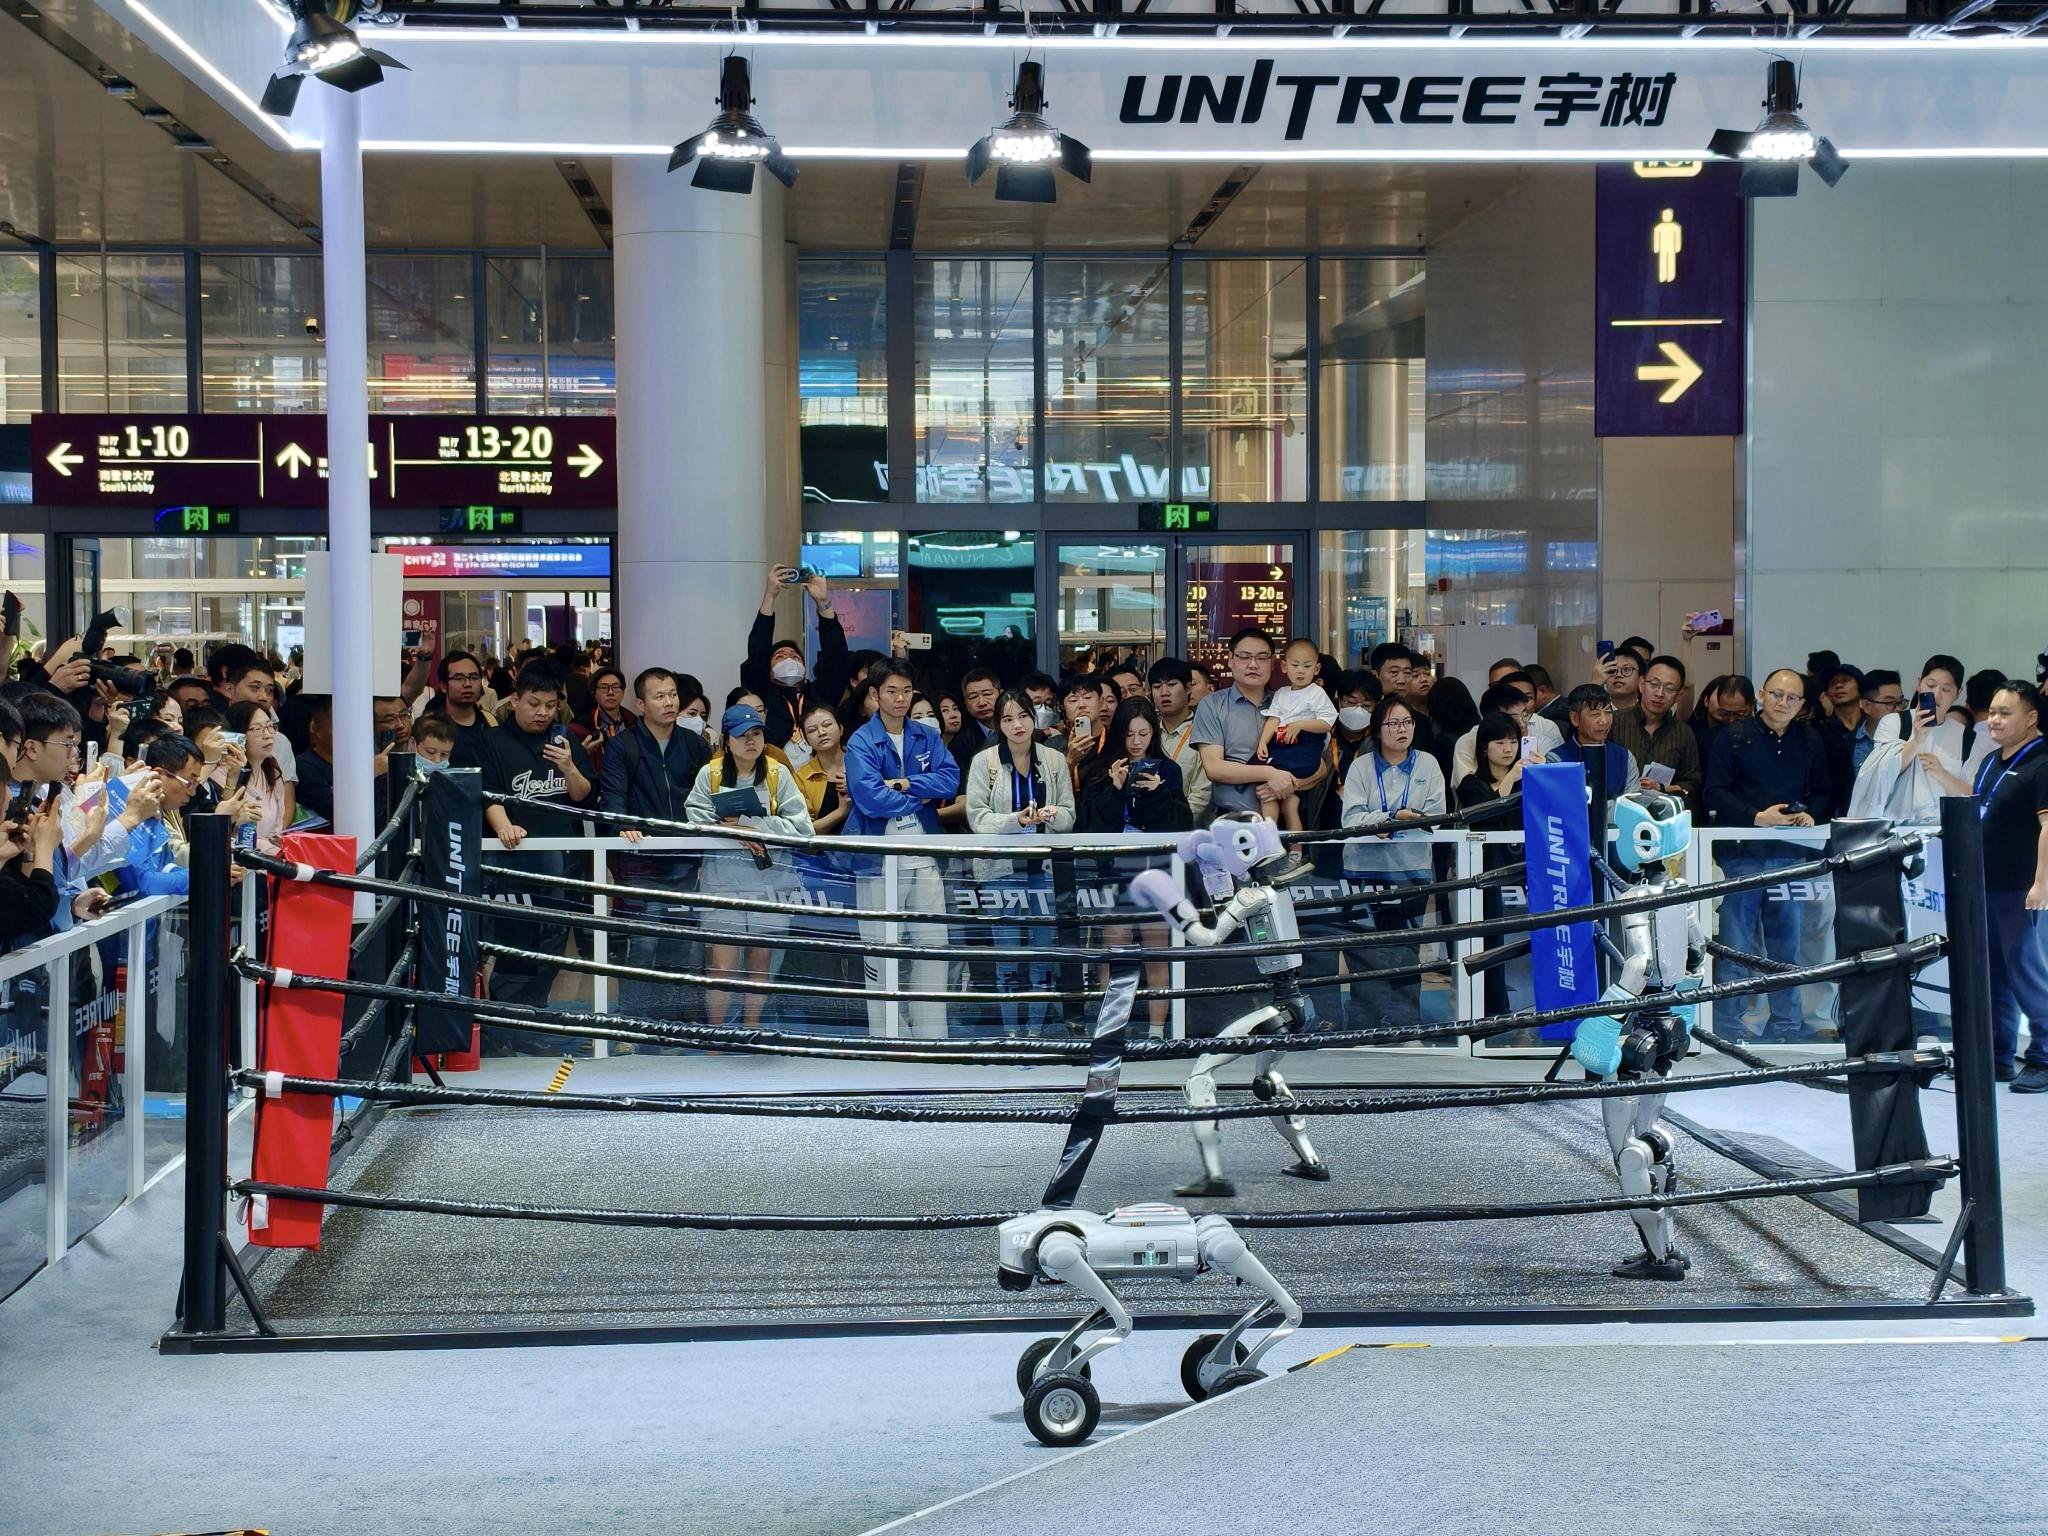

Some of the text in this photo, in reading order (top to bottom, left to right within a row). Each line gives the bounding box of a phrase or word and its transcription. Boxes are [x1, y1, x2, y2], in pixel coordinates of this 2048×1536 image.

[1120, 59, 1677, 140] UNITREE 宇树
[125, 425, 189, 457] 1-10
[466, 426, 553, 458] 13-20
[99, 482, 155, 495] South Lobby
[498, 483, 553, 495] North Lobby
[1241, 586, 1274, 600] 13-20
[444, 821, 466, 953] UNITEE
[1546, 816, 1576, 991] UNITRE 宇树
[1012, 1233, 1026, 1246] 02
